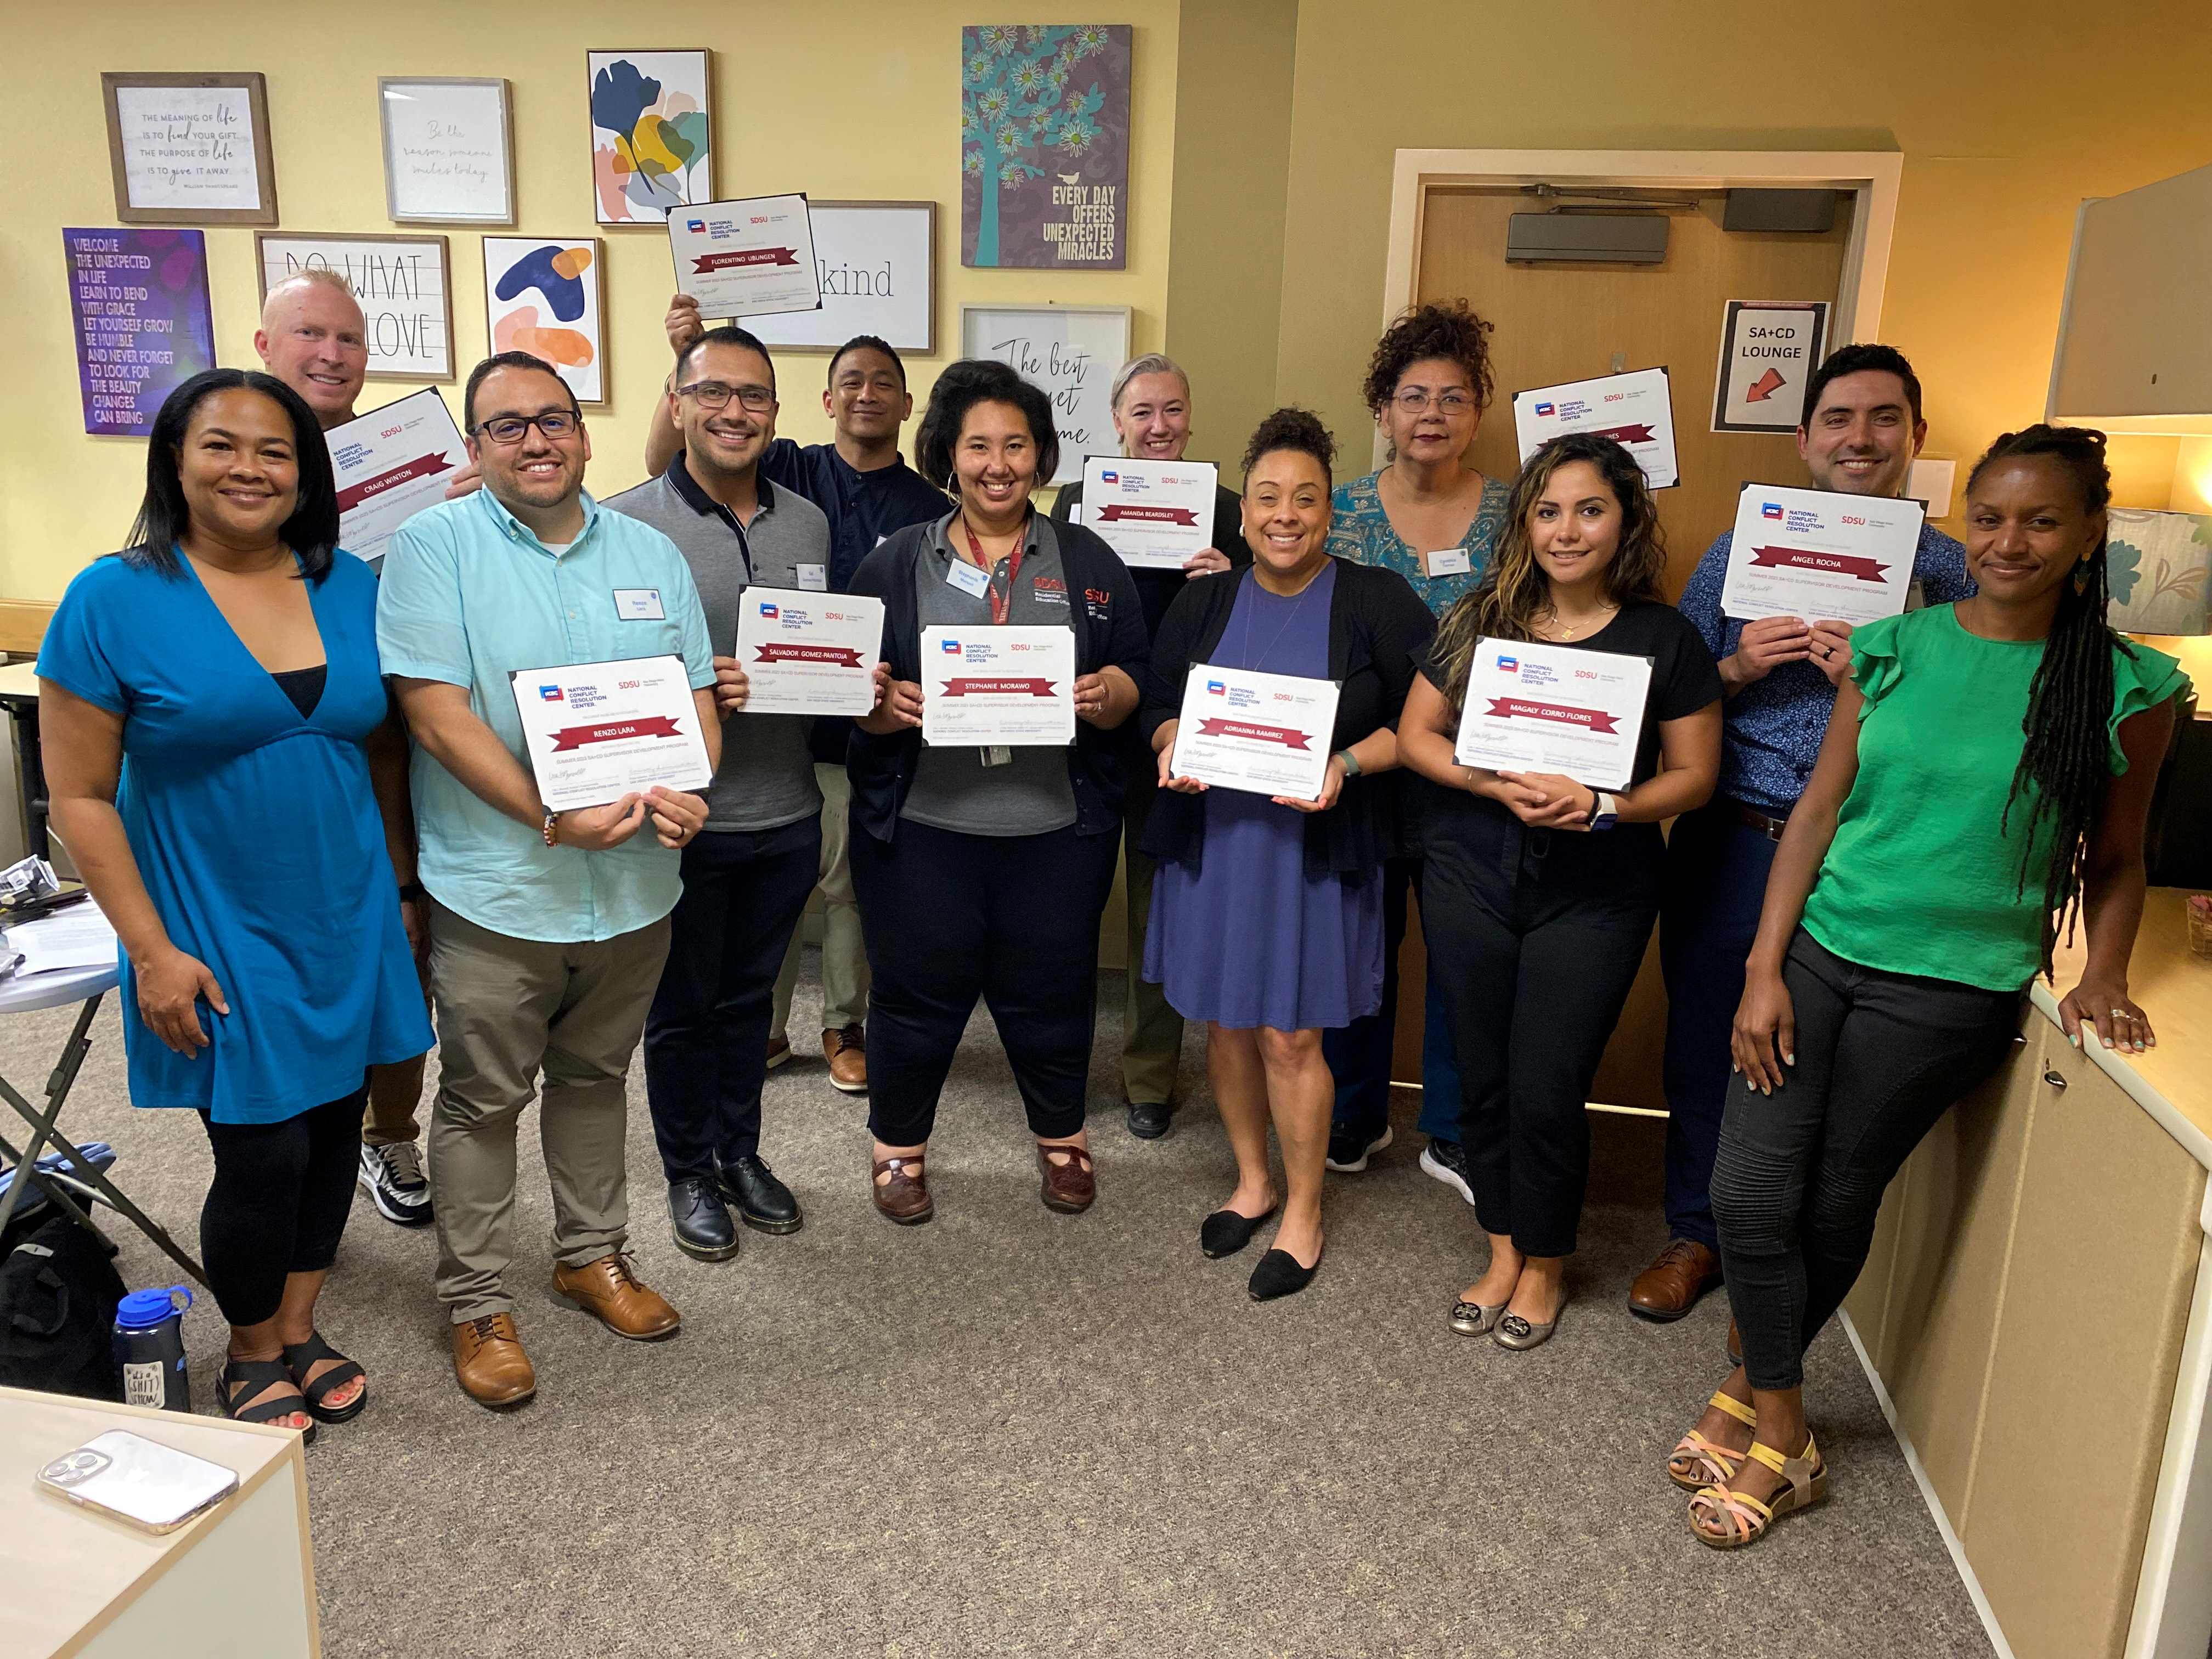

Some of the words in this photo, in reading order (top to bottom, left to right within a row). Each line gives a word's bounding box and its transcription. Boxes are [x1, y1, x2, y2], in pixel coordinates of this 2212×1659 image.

[217, 103, 237, 126] life
[168, 121, 191, 143] find
[428, 120, 443, 139] Be
[213, 140, 233, 161] life
[169, 168, 191, 185] give
[1053, 186, 1087, 205] EVERY
[1093, 186, 1115, 205] DAY
[1073, 205, 1115, 223] OFFERS
[1043, 223, 1115, 242] UNEXPECTED
[74, 238, 119, 252] WELCOME
[1058, 241, 1114, 261] MIRACLES
[76, 254, 92, 268] THE
[94, 255, 151, 269] UNEXPECTED
[712, 256, 746, 265] FLORENTINO
[748, 253, 775, 262] UBUNGEN
[78, 270, 88, 283] IN
[91, 270, 107, 283] LIFE
[346, 254, 421, 300] WHAT
[820, 260, 894, 297] kind
[80, 286, 107, 299] LEARN
[109, 287, 121, 300] TO
[124, 287, 148, 301] BEND
[81, 302, 104, 315] WITH
[106, 302, 136, 315] GRACE
[84, 318, 97, 330] LET
[98, 318, 142, 331] YOURSELF
[144, 319, 173, 333] GROW
[1749, 327, 1795, 338] SA+CD
[85, 333, 97, 346] BE
[99, 334, 134, 347] HUMBLE
[365, 312, 433, 358] LOVE
[88, 349, 107, 362] AND
[110, 350, 138, 363] NEVER
[140, 352, 173, 365] FORGET
[1742, 347, 1802, 358] LOUNGE
[992, 337, 1042, 374] The
[1051, 342, 1092, 383] best
[89, 364, 101, 377] TO
[104, 365, 129, 378] LOOK
[132, 366, 150, 379] FOR
[91, 380, 107, 393] THE
[109, 380, 142, 394] BEAUTY
[93, 396, 135, 409] CHANGES
[1559, 400, 1585, 408] NATIONAL
[1604, 393, 1624, 402] SDSU
[94, 411, 114, 424] CAN
[116, 411, 143, 424] BRING
[381, 425, 402, 439] SDSU
[334, 441, 362, 456] NATIONAL
[336, 447, 363, 461] CONFLICT
[364, 479, 385, 494] CRAIG
[384, 469, 413, 485] WINTON
[1841, 516, 1865, 525] SDSU
[1791, 555, 1815, 565] ANGEL
[1816, 558, 1842, 568] ROCHA
[801, 651, 848, 659] GOMEZ-PANTOJA
[1523, 668, 1551, 676] CONFLICT
[1524, 663, 1553, 672] NATIONAL
[1575, 670, 1598, 680] SDSU
[618, 680, 640, 690] SDSU
[1273, 693, 1293, 702] SDSU
[1510, 704, 1539, 714] MAGALY
[1541, 709, 1566, 719] CORRO
[1566, 712, 1592, 722] FLORES
[594, 729, 617, 738] RENZO
[618, 726, 636, 735] LARA
[1223, 725, 1256, 735] ADRIANNA
[1256, 730, 1284, 739] RAMIREZ
